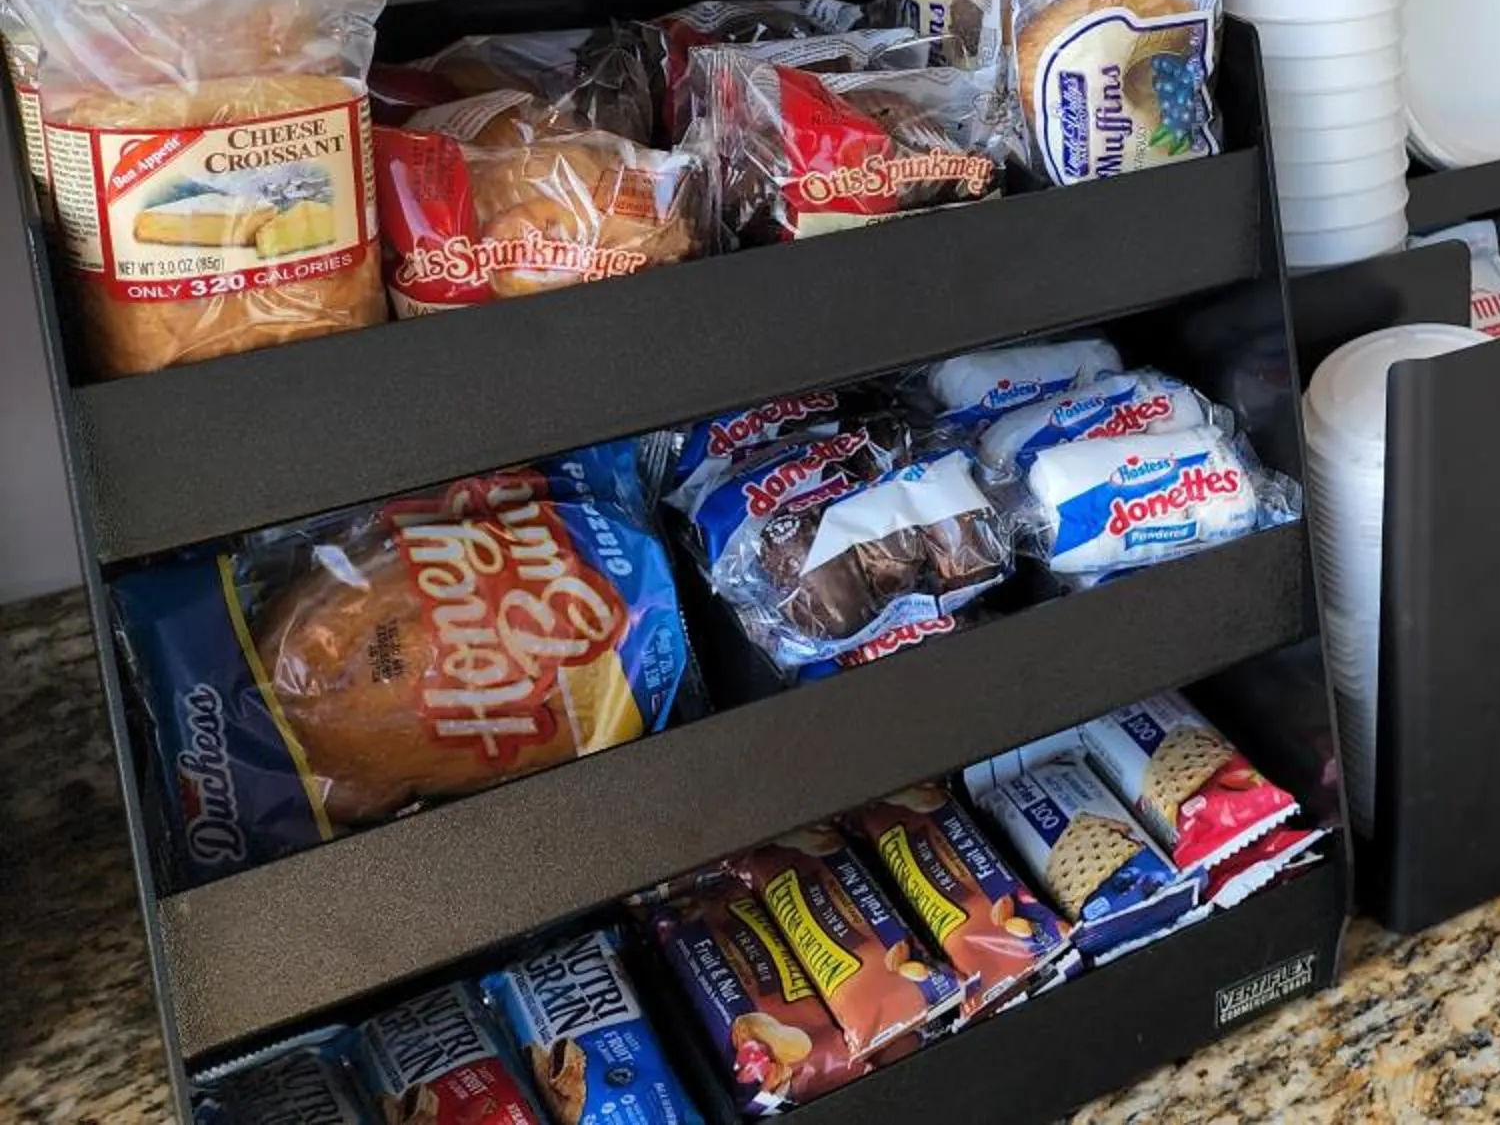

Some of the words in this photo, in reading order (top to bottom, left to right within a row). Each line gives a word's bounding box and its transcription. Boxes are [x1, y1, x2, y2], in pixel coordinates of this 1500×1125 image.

[227, 118, 328, 150] CHEESE
[1096, 65, 1132, 178] Muffins
[204, 134, 347, 174] CROISSANT
[127, 283, 181, 299] ONLY
[190, 274, 245, 297] 320
[254, 253, 354, 286] CALORIES
[988, 382, 1038, 407] Hostess
[1053, 395, 1104, 421] Hostess
[1116, 458, 1173, 483] Hostess
[1105, 466, 1240, 536] donettes
[1131, 525, 1190, 544] Powdered
[401, 488, 539, 756] Honey
[490, 481, 614, 663] Bun
[180, 684, 246, 863] Duchess
[942, 814, 968, 842] Nut
[1030, 800, 1062, 833] 100
[958, 837, 975, 852] &
[835, 859, 862, 887] Nut
[964, 846, 995, 881] Fruit
[849, 881, 870, 900] &
[821, 904, 850, 939] TRAIL
[856, 890, 891, 928] Fruit
[691, 935, 724, 971] Fruit
[566, 932, 630, 1024] NUTRI
[709, 964, 729, 980] &
[525, 949, 592, 1037] GRAIN
[715, 974, 745, 1006] Nut
[378, 1002, 447, 1088] GRAIN
[416, 988, 484, 1067] NUTRI
[604, 1028, 634, 1066] FRUIT
